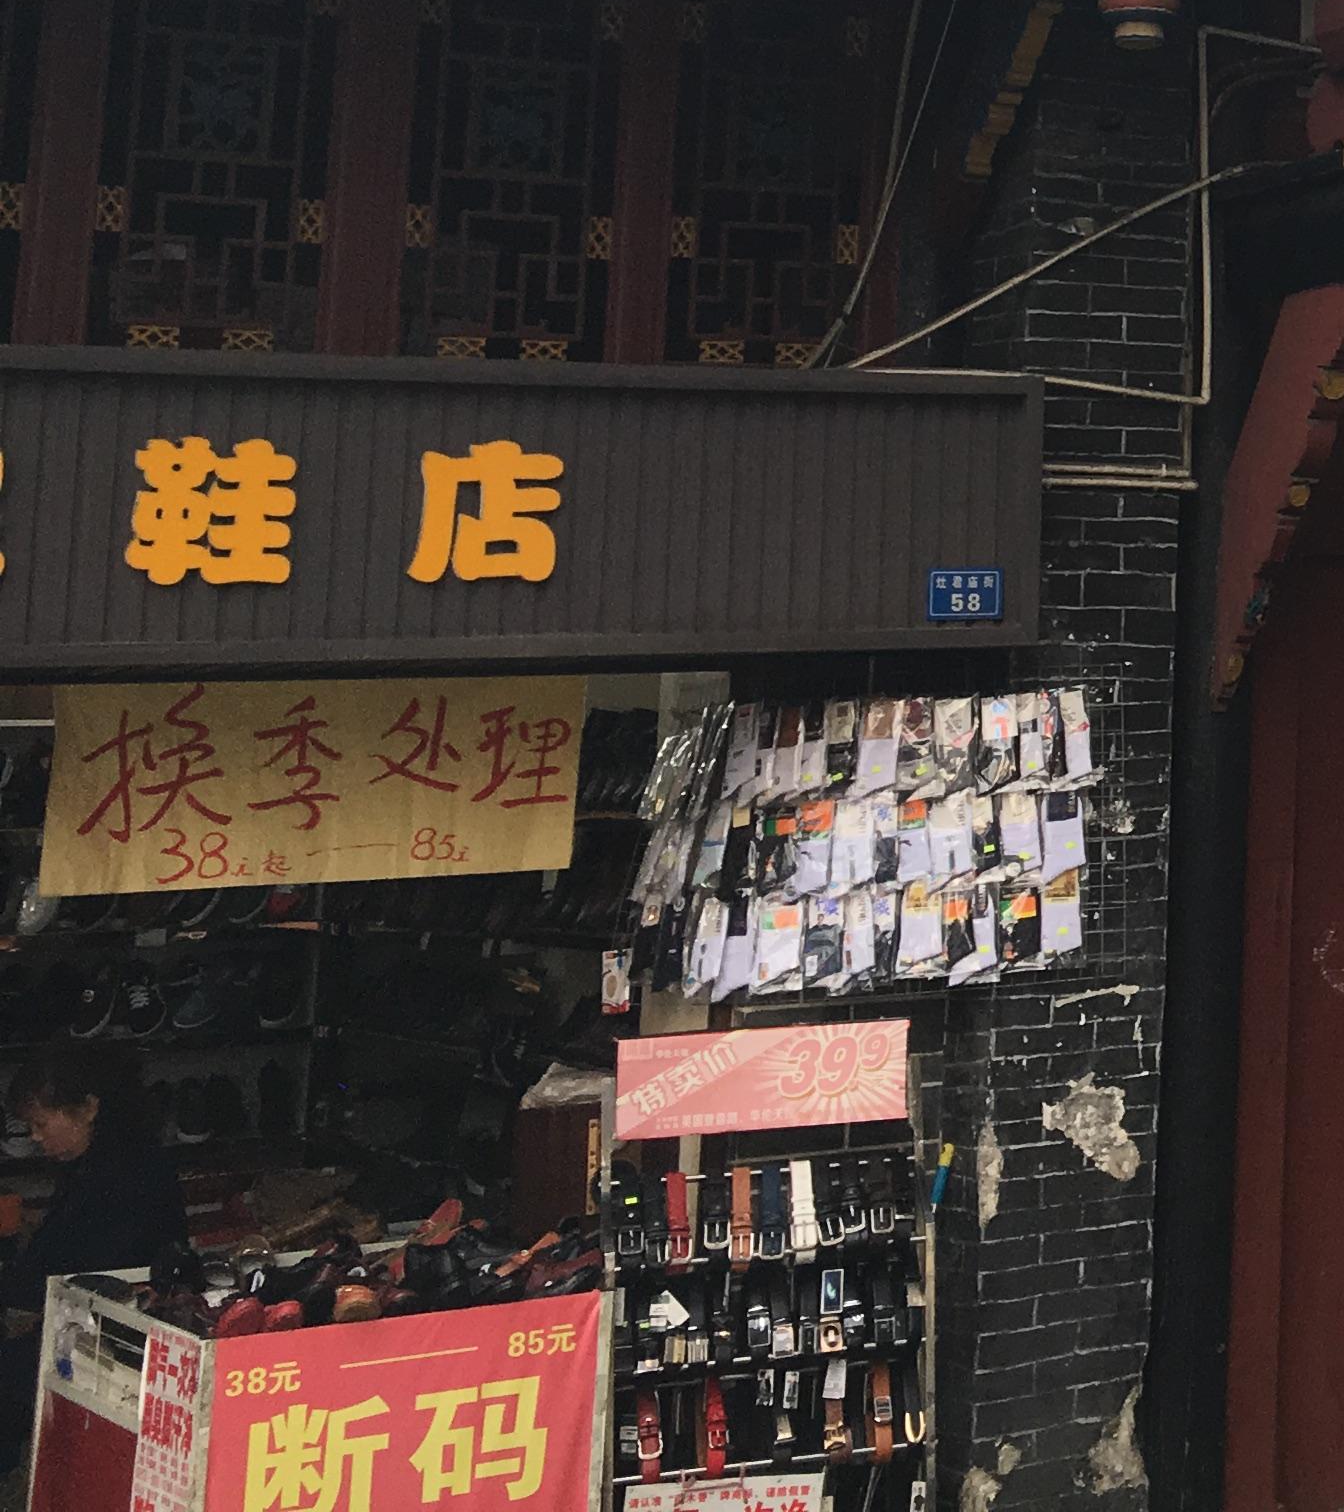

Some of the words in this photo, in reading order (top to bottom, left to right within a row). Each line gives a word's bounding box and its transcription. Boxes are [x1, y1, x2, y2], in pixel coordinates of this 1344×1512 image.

[0, 435, 564, 585] 鞋店
[951, 593, 981, 612] 58
[77, 682, 572, 843] 换季处理
[224, 1360, 302, 1398] 38元
[507, 1323, 577, 1358] 85元
[242, 1375, 549, 1512] 断码
